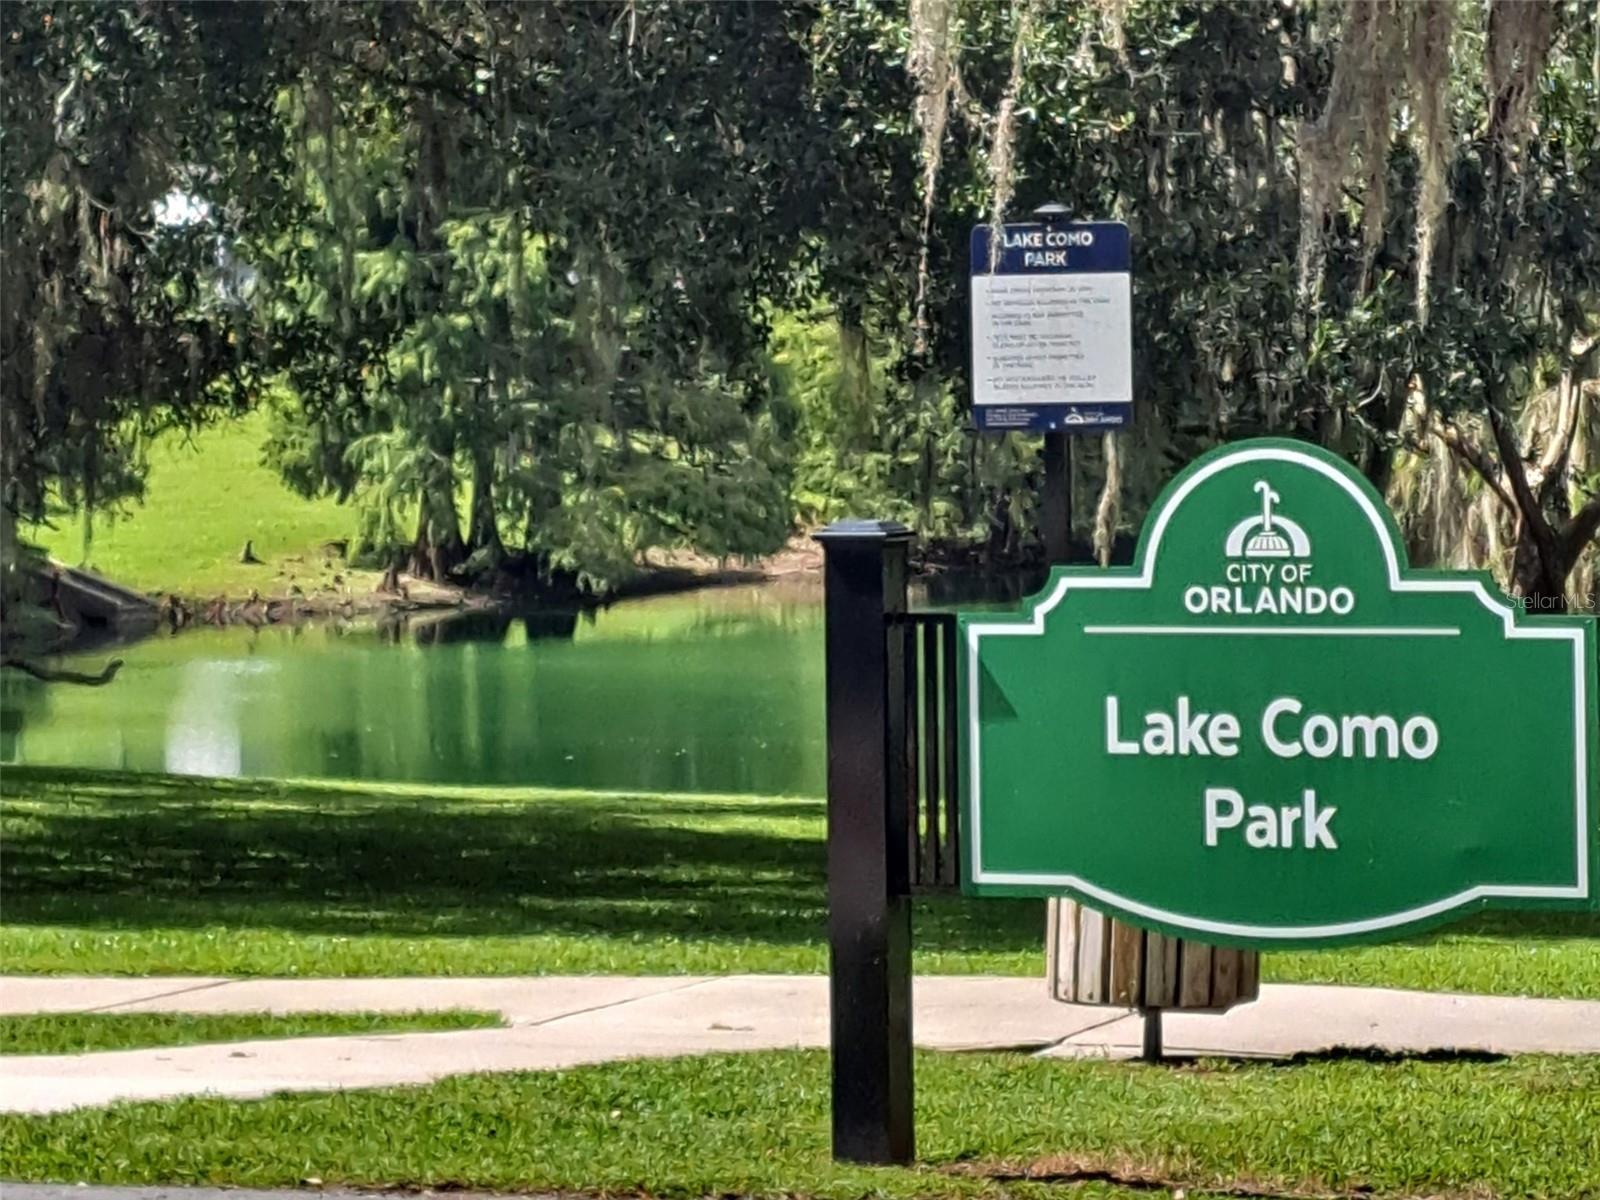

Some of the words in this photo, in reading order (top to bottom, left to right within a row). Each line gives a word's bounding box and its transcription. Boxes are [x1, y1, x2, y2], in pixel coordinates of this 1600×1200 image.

[1003, 232, 1043, 248] LAKE
[1046, 232, 1093, 247] COMO
[1024, 251, 1068, 267] PARK
[1226, 564, 1275, 584] CITY
[1281, 564, 1313, 583] OF
[1184, 586, 1355, 615] ORLANDO
[1106, 696, 1241, 757] Lake
[1262, 698, 1439, 760] Como
[1205, 788, 1338, 849] Park
